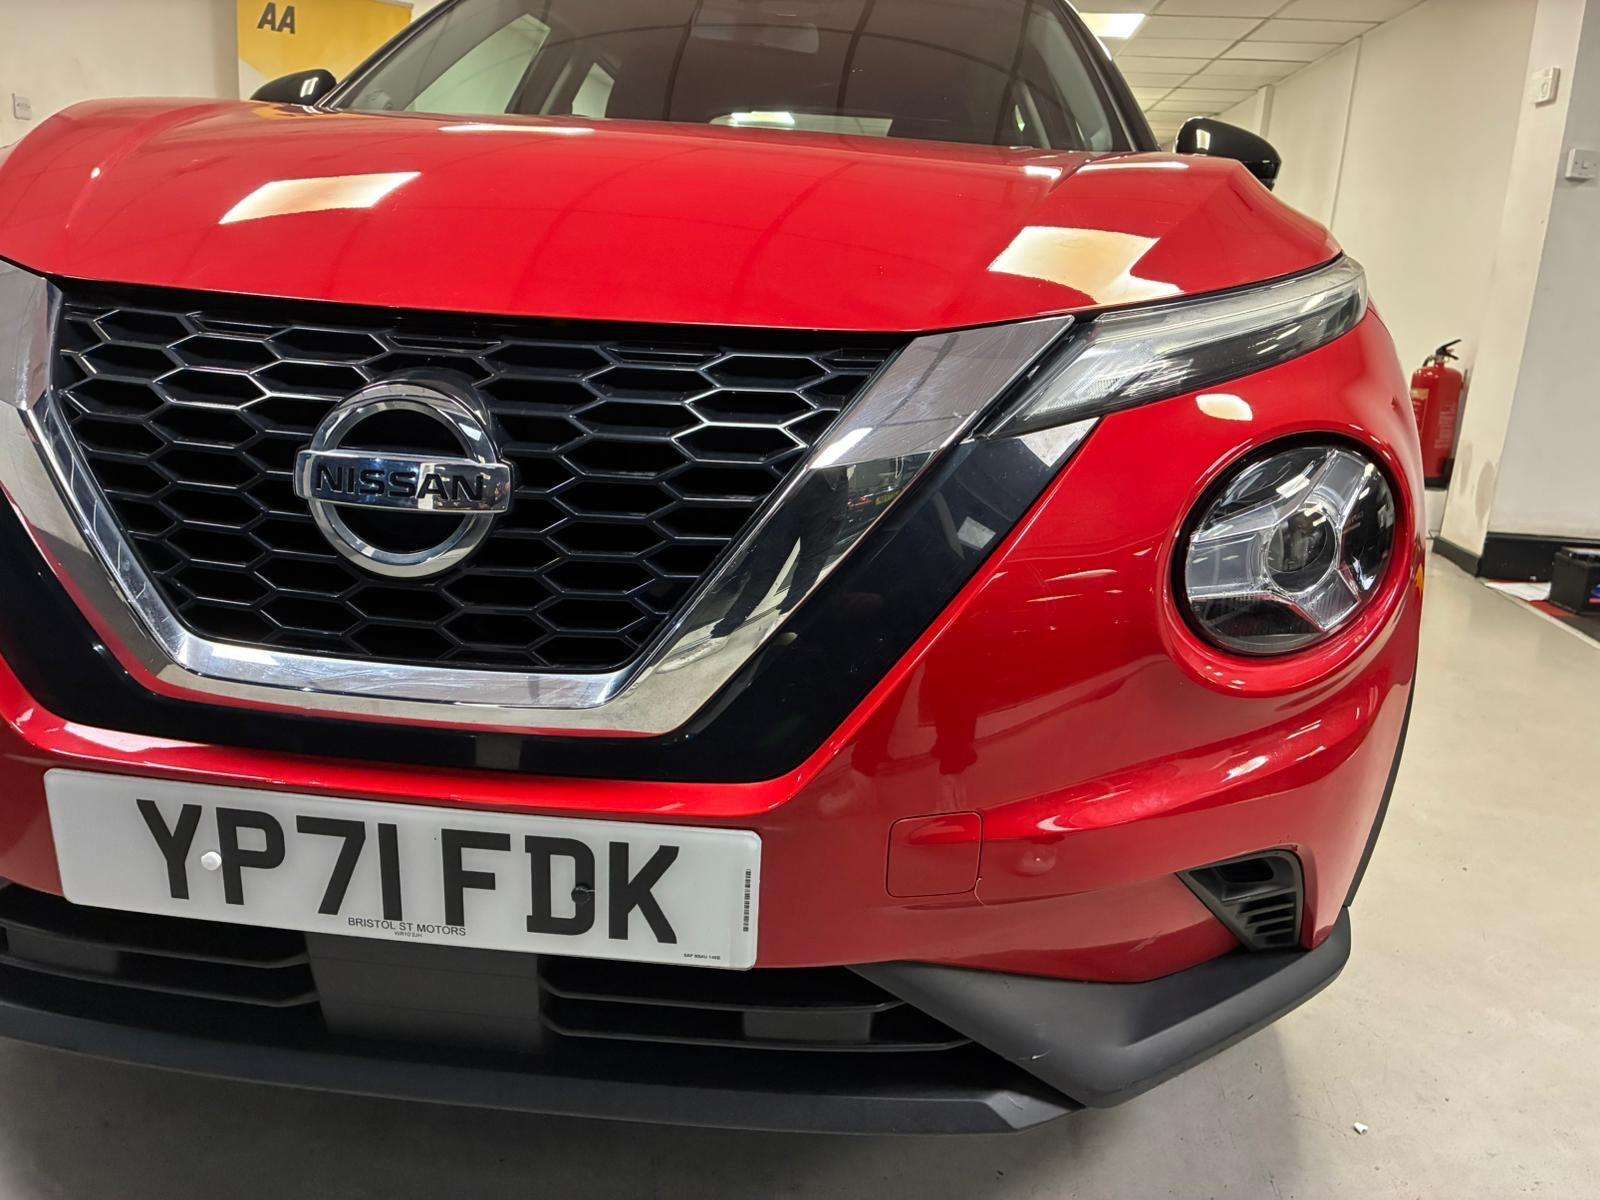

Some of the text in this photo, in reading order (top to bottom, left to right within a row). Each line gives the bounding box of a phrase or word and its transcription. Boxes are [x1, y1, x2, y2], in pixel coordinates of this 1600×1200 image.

[257, 2, 295, 34] AA
[316, 464, 485, 501] NISSAN
[136, 798, 403, 922] YP71
[441, 828, 680, 945] FDK
[348, 917, 466, 936] BRISTOL ST MOTORS
